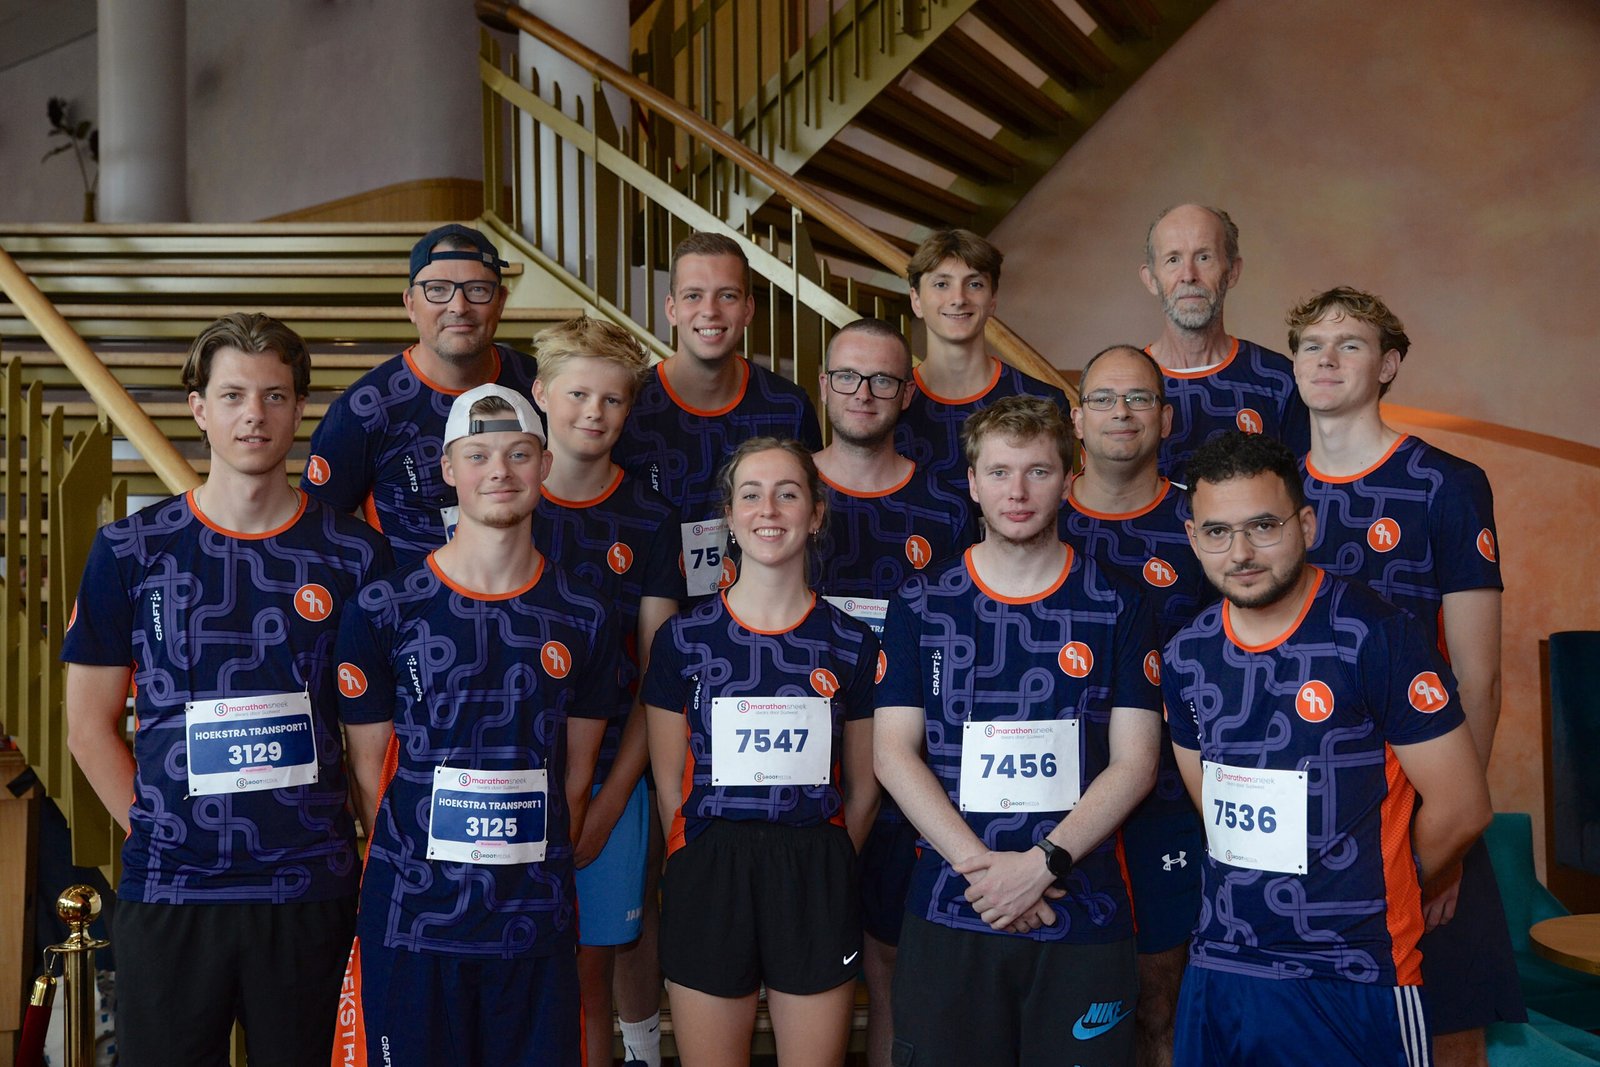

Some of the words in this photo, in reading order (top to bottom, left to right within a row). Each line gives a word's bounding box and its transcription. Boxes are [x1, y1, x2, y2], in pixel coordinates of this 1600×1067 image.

[152, 601, 163, 641] CRAFT
[932, 659, 940, 696] CRAFT
[195, 729, 247, 740] HOEKSTRA
[249, 723, 302, 735] TRANSPORT
[303, 722, 308, 730] 1
[735, 728, 809, 753] 7547
[228, 741, 282, 765] 3129
[980, 752, 1057, 778] 7456
[439, 798, 487, 810] HOEKSTRA
[488, 801, 537, 810] TRANSPORT
[537, 800, 542, 808] 1
[1214, 799, 1277, 834] 7536
[465, 816, 518, 837] 3125
[1083, 1000, 1122, 1024] NIKE
[381, 1035, 392, 1067] CRAFT
